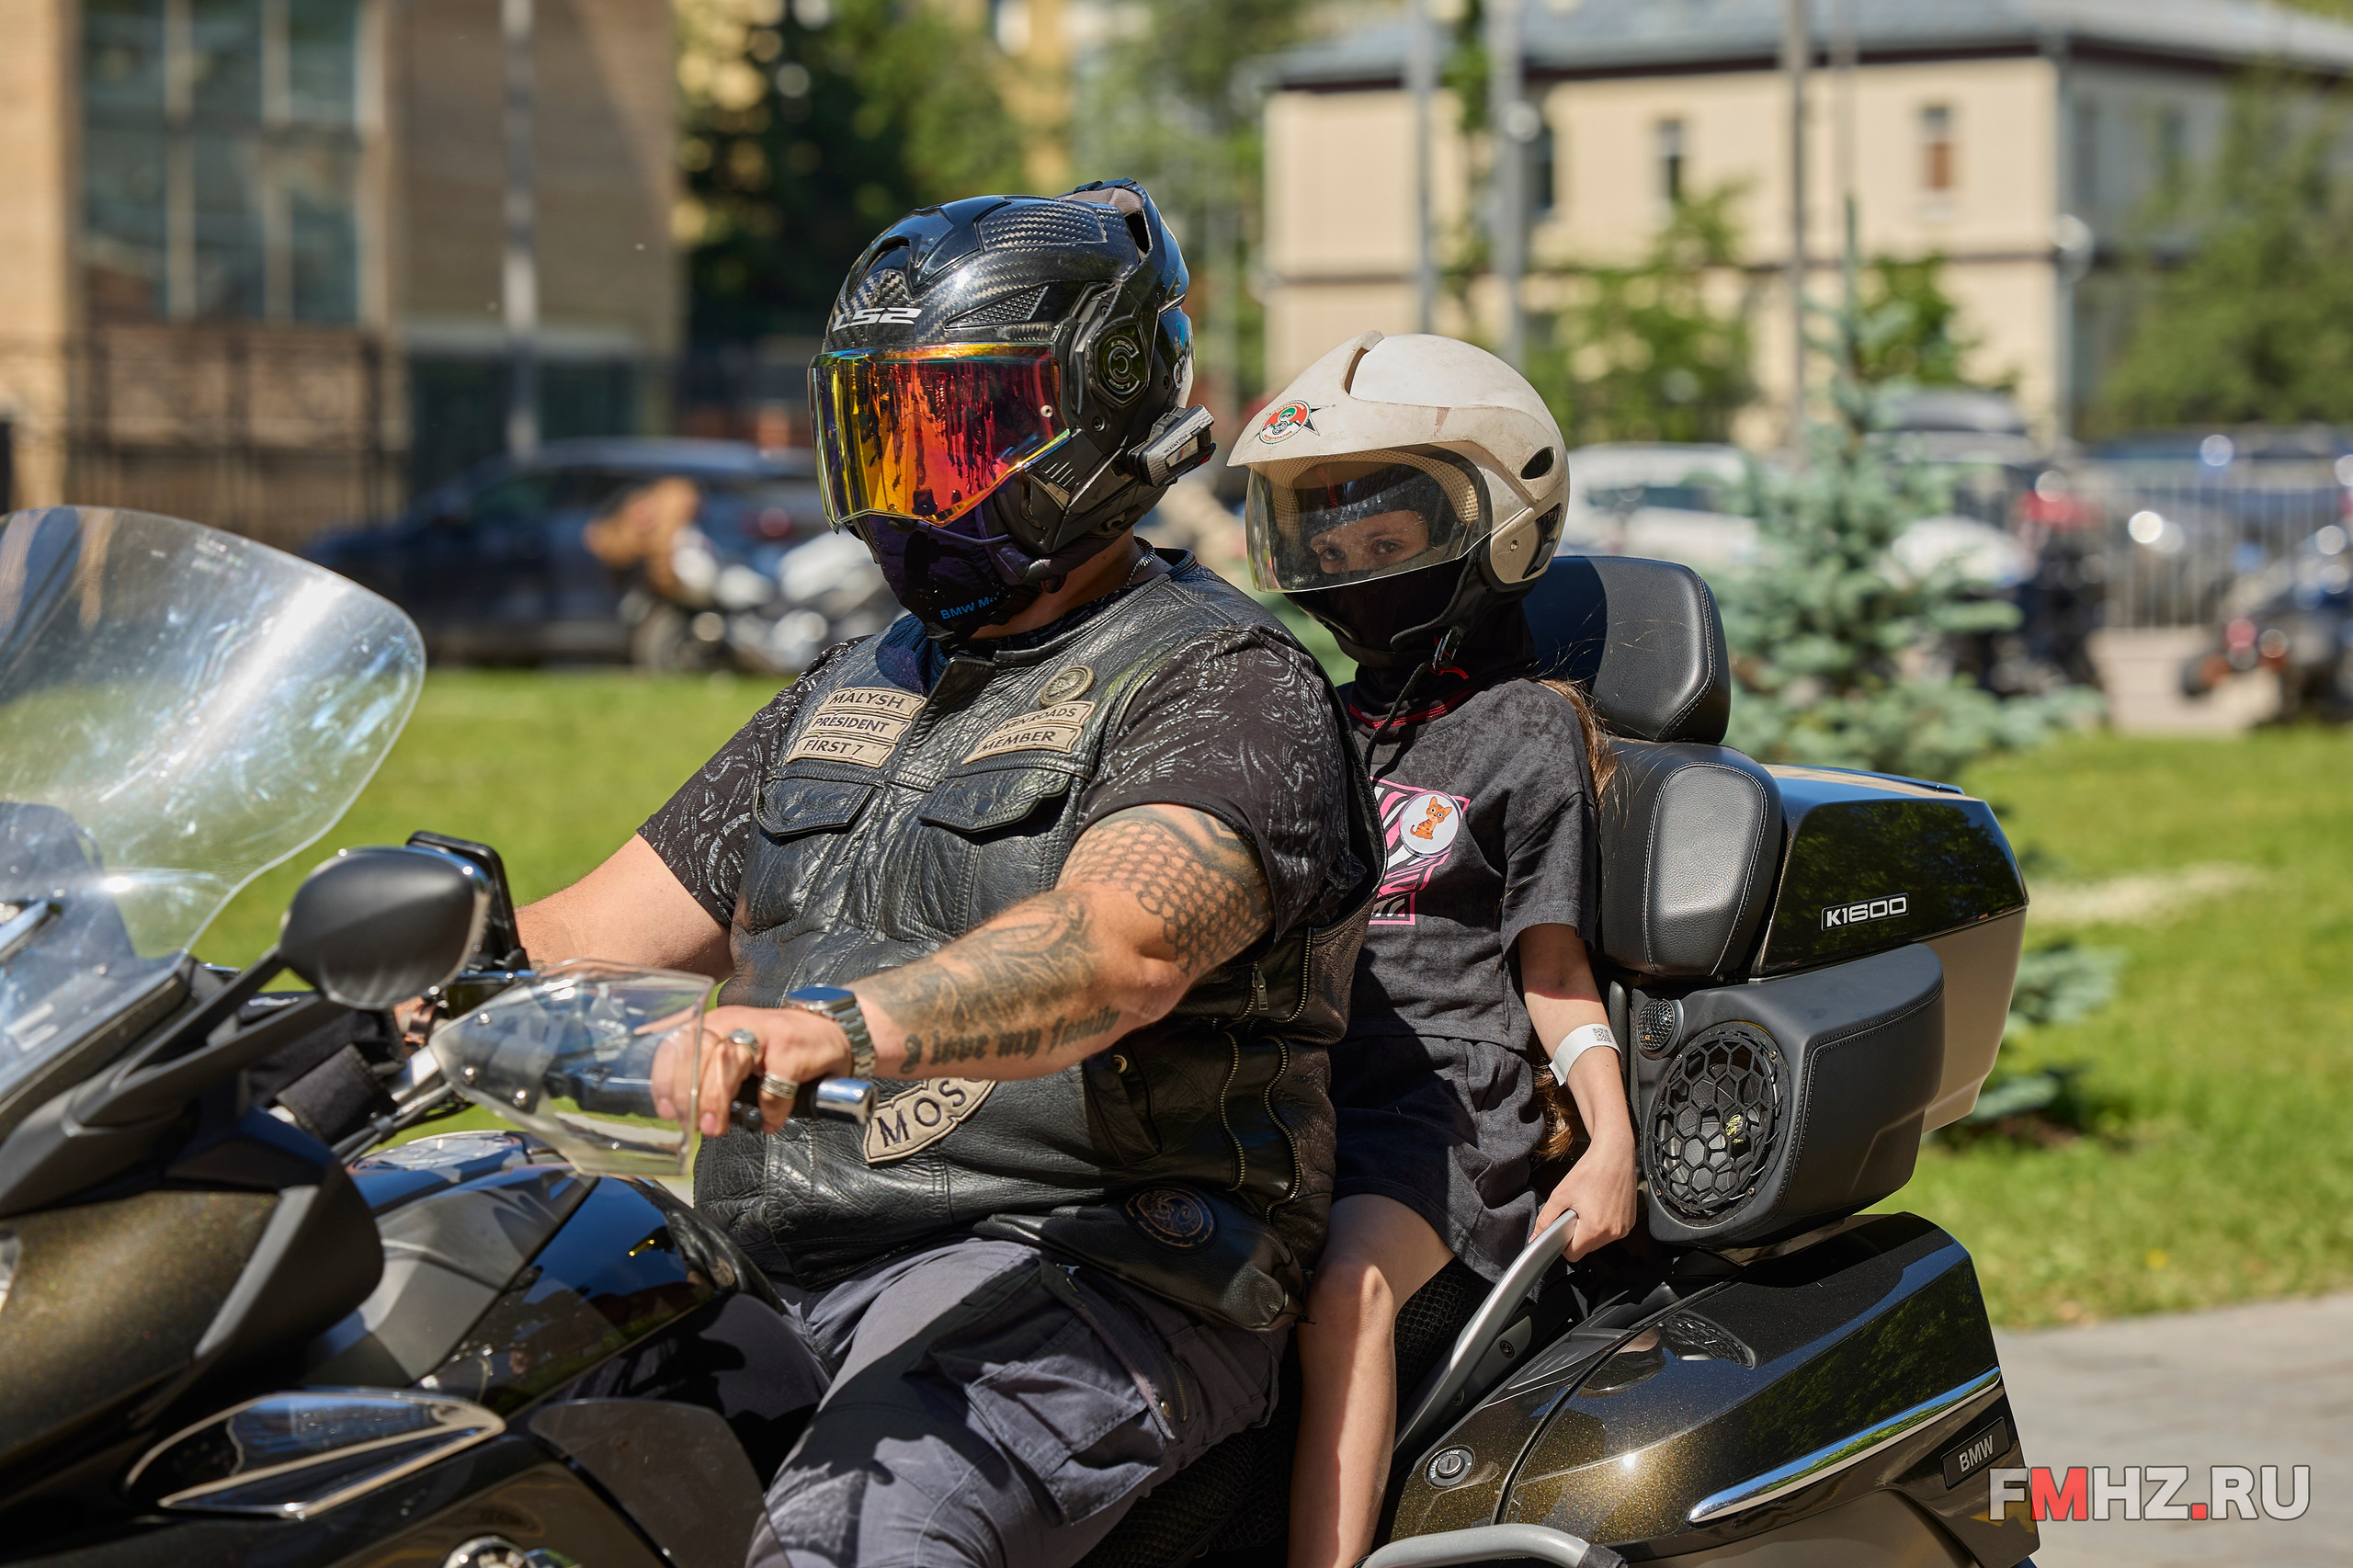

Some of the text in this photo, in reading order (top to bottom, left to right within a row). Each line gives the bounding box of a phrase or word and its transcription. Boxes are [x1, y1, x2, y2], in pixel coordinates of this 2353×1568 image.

[832, 307, 923, 332] LS2
[940, 602, 974, 619] BMW
[828, 692, 906, 709] MALYSH
[812, 716, 890, 733] PRESIDENT
[802, 739, 864, 756] FIRST 7
[977, 731, 1056, 754] MEMBER
[1826, 897, 1907, 927] K1600
[874, 1079, 981, 1147] MOS
[1959, 1435, 1994, 1472] BMW
